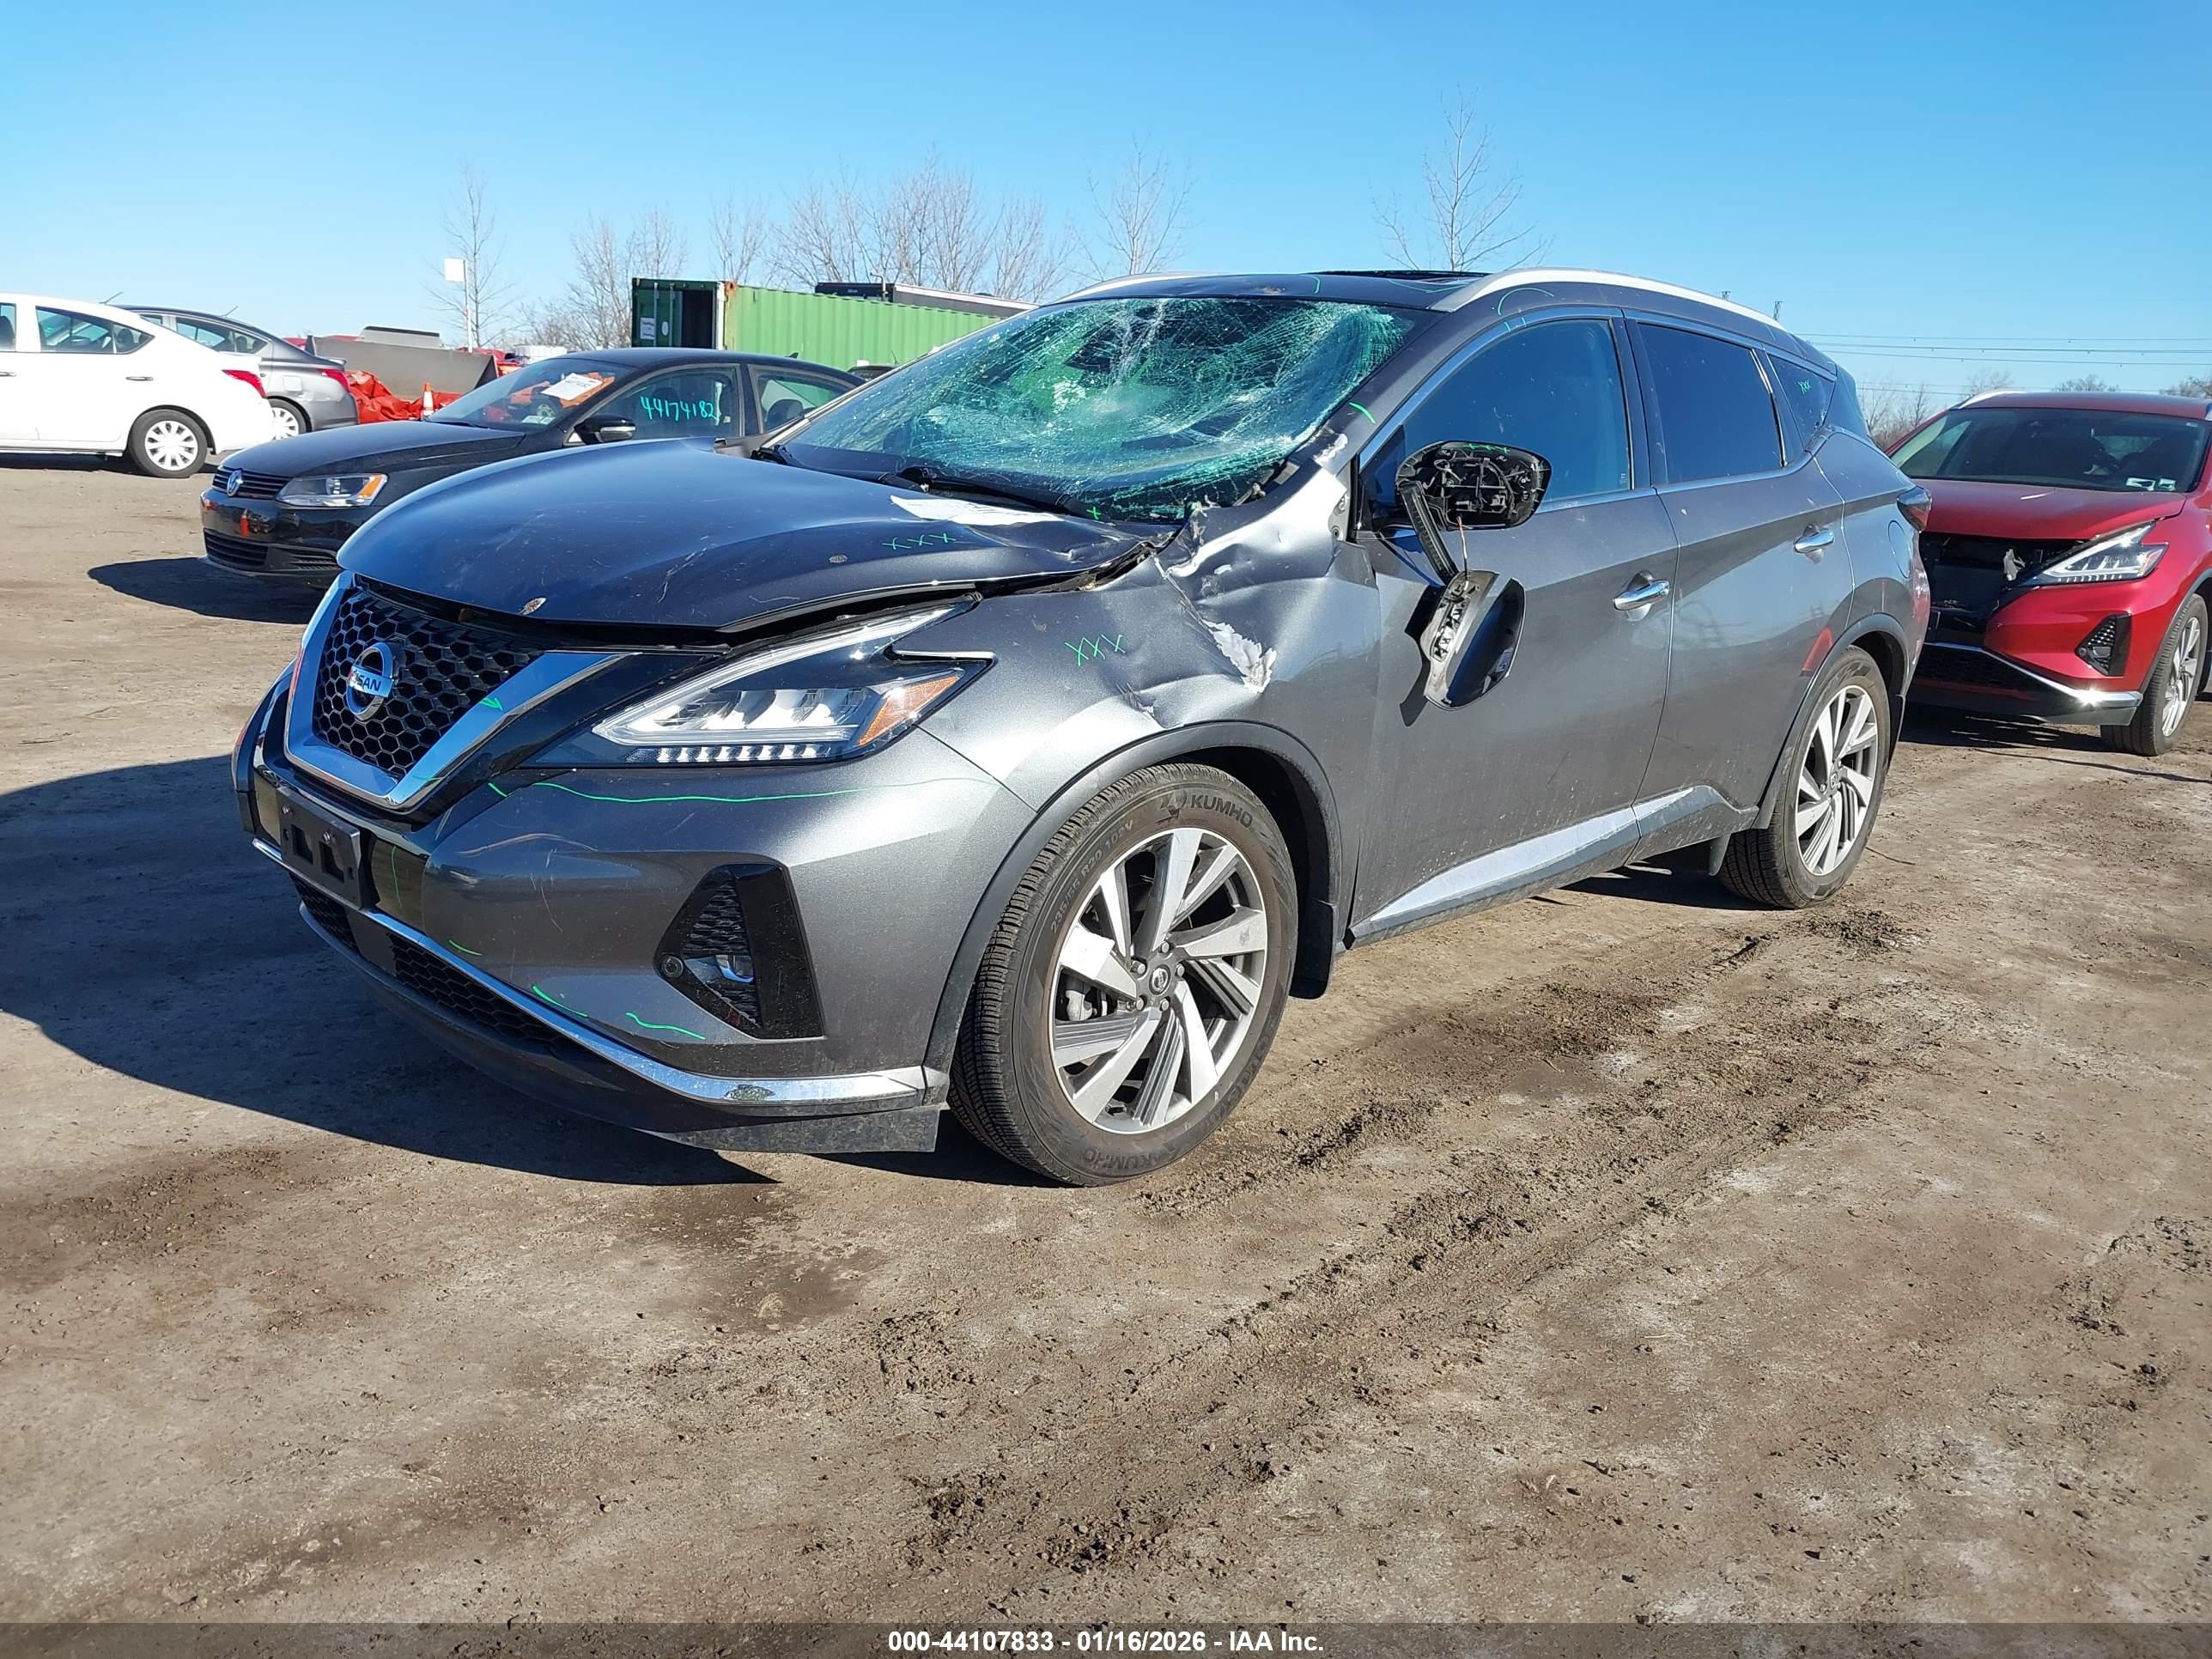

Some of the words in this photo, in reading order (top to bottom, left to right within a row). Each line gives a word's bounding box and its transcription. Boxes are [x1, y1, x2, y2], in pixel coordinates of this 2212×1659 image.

[640, 396, 718, 422] 44174182
[1190, 793, 1254, 829] KUMHO
[1080, 848, 1103, 878] R20
